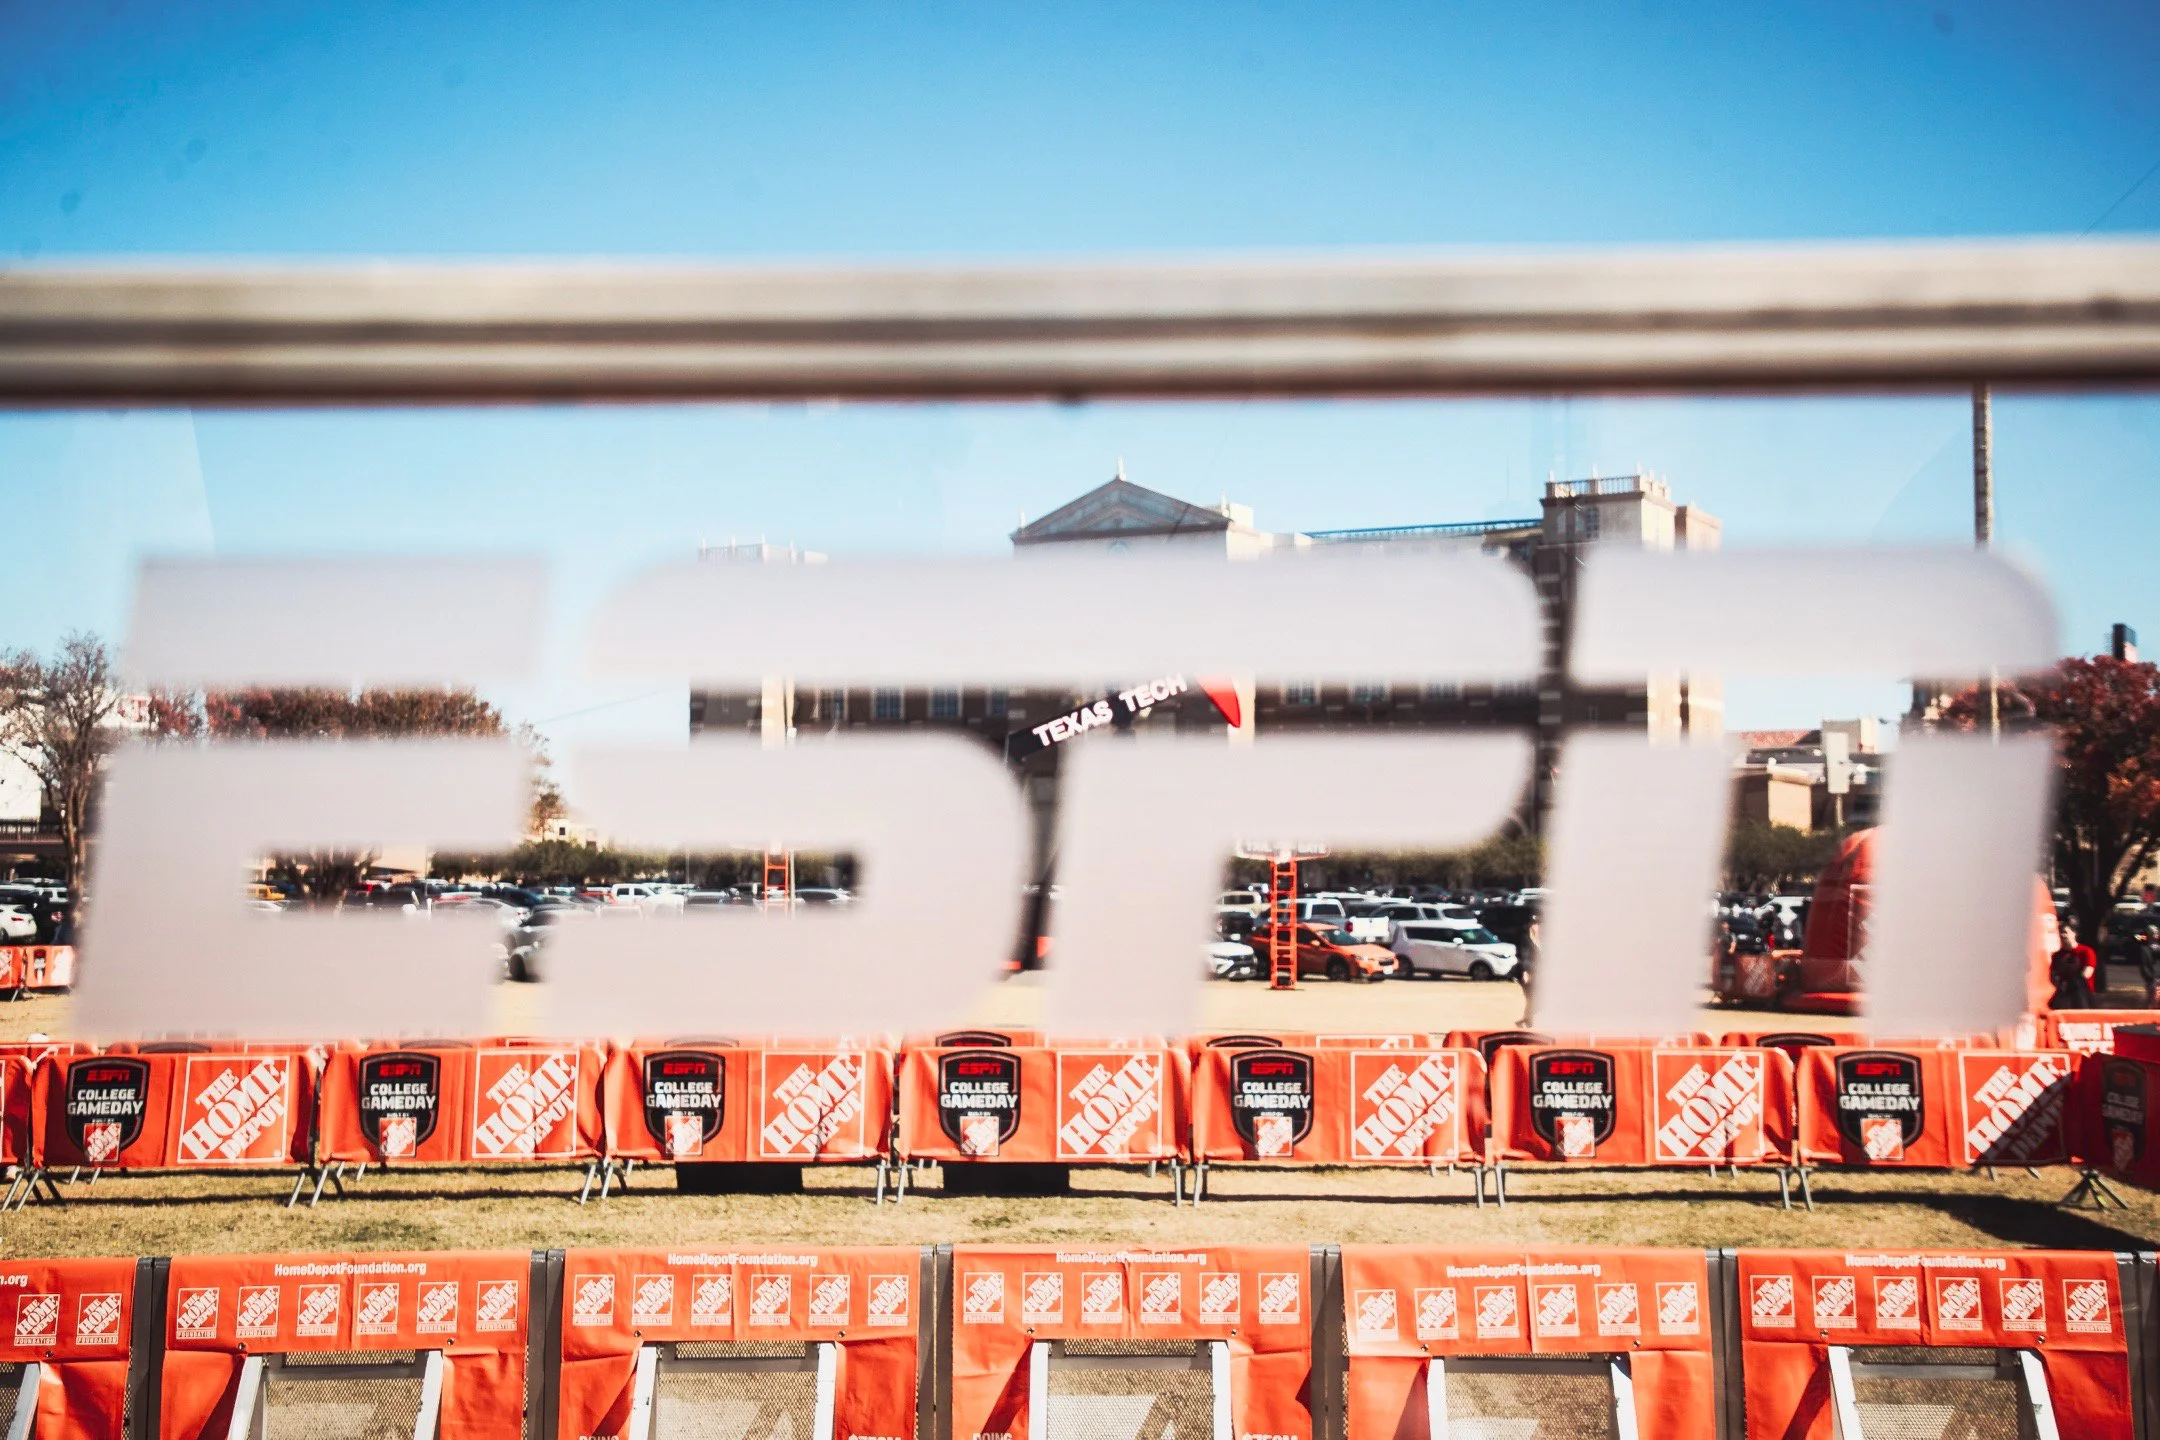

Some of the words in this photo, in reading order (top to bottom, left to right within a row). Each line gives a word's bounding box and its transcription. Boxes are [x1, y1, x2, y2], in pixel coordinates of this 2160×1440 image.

[1032, 700, 1113, 746] TEXAS
[1119, 673, 1188, 712] TECH
[80, 546, 2060, 1040] ESPN
[87, 1070, 129, 1082] ESPN
[380, 1064, 421, 1076] ESPN
[486, 1063, 529, 1105] THE
[664, 1062, 705, 1074] ESPN
[773, 1063, 816, 1104] THE
[958, 1063, 1000, 1075] ESPN
[1069, 1063, 1112, 1104] THE
[1252, 1063, 1294, 1075] ESPN
[1362, 1063, 1407, 1105] THE
[1542, 1081, 1602, 1093] COLLEGE
[1550, 1062, 1594, 1074] ESPN
[1665, 1063, 1710, 1105] THE
[1856, 1063, 1900, 1076] ESPN
[1974, 1065, 2018, 1108] THE
[78, 1089, 135, 1101] COLLEGE
[195, 1068, 239, 1111] THE
[361, 1096, 436, 1110] GAMEDAY
[370, 1083, 428, 1095] COLLEGE
[476, 1052, 577, 1156] HOME
[646, 1094, 722, 1108] GAMEDAY
[655, 1082, 713, 1094] COLLEGE
[763, 1053, 864, 1155] HOME
[941, 1095, 1018, 1108] GAMEDAY
[950, 1082, 1008, 1094] COLLEGE
[1061, 1053, 1159, 1154] HOME
[1234, 1095, 1311, 1109] GAMEDAY
[1242, 1082, 1301, 1094] COLLEGE
[1354, 1054, 1456, 1156] HOME
[1533, 1095, 1613, 1109] GAMEDAY
[1659, 1050, 1759, 1157] HOME
[1839, 1096, 1919, 1111] GAMEDAY
[1848, 1083, 1911, 1095] COLLEGE
[68, 1101, 143, 1115] GAMEDAY
[182, 1056, 287, 1160] HOME
[514, 1090, 576, 1155] DEPOT
[800, 1091, 863, 1154] DEPOT
[1097, 1090, 1159, 1155] DEPOT
[1394, 1092, 1455, 1156] DEPOT
[1699, 1092, 1760, 1157] DEPOT
[1968, 1055, 2070, 1161] HOME
[220, 1096, 287, 1160] DEPOT
[274, 1262, 426, 1277] HomeDepotFoundation.org
[668, 1252, 818, 1267] HomeDepotFoundation.org
[1056, 1252, 1206, 1266] HomeDepotFoundation.org
[1446, 1263, 1601, 1278] HomeDepotFoundation.org
[1845, 1254, 2006, 1271] HomeDepotFoundation.org
[18, 1295, 58, 1334] HOME
[22, 1299, 40, 1315] THE
[79, 1294, 120, 1333] HOME
[84, 1298, 101, 1314] THE
[179, 1288, 218, 1327] HOME
[239, 1287, 278, 1326] HOME
[299, 1285, 338, 1324] HOME
[359, 1284, 398, 1323] HOME
[419, 1283, 457, 1321] HOME
[478, 1281, 517, 1320] HOME
[1940, 1278, 1978, 1318] HOME
[2004, 1280, 2041, 1319] HOME
[2067, 1281, 2105, 1320] HOME
